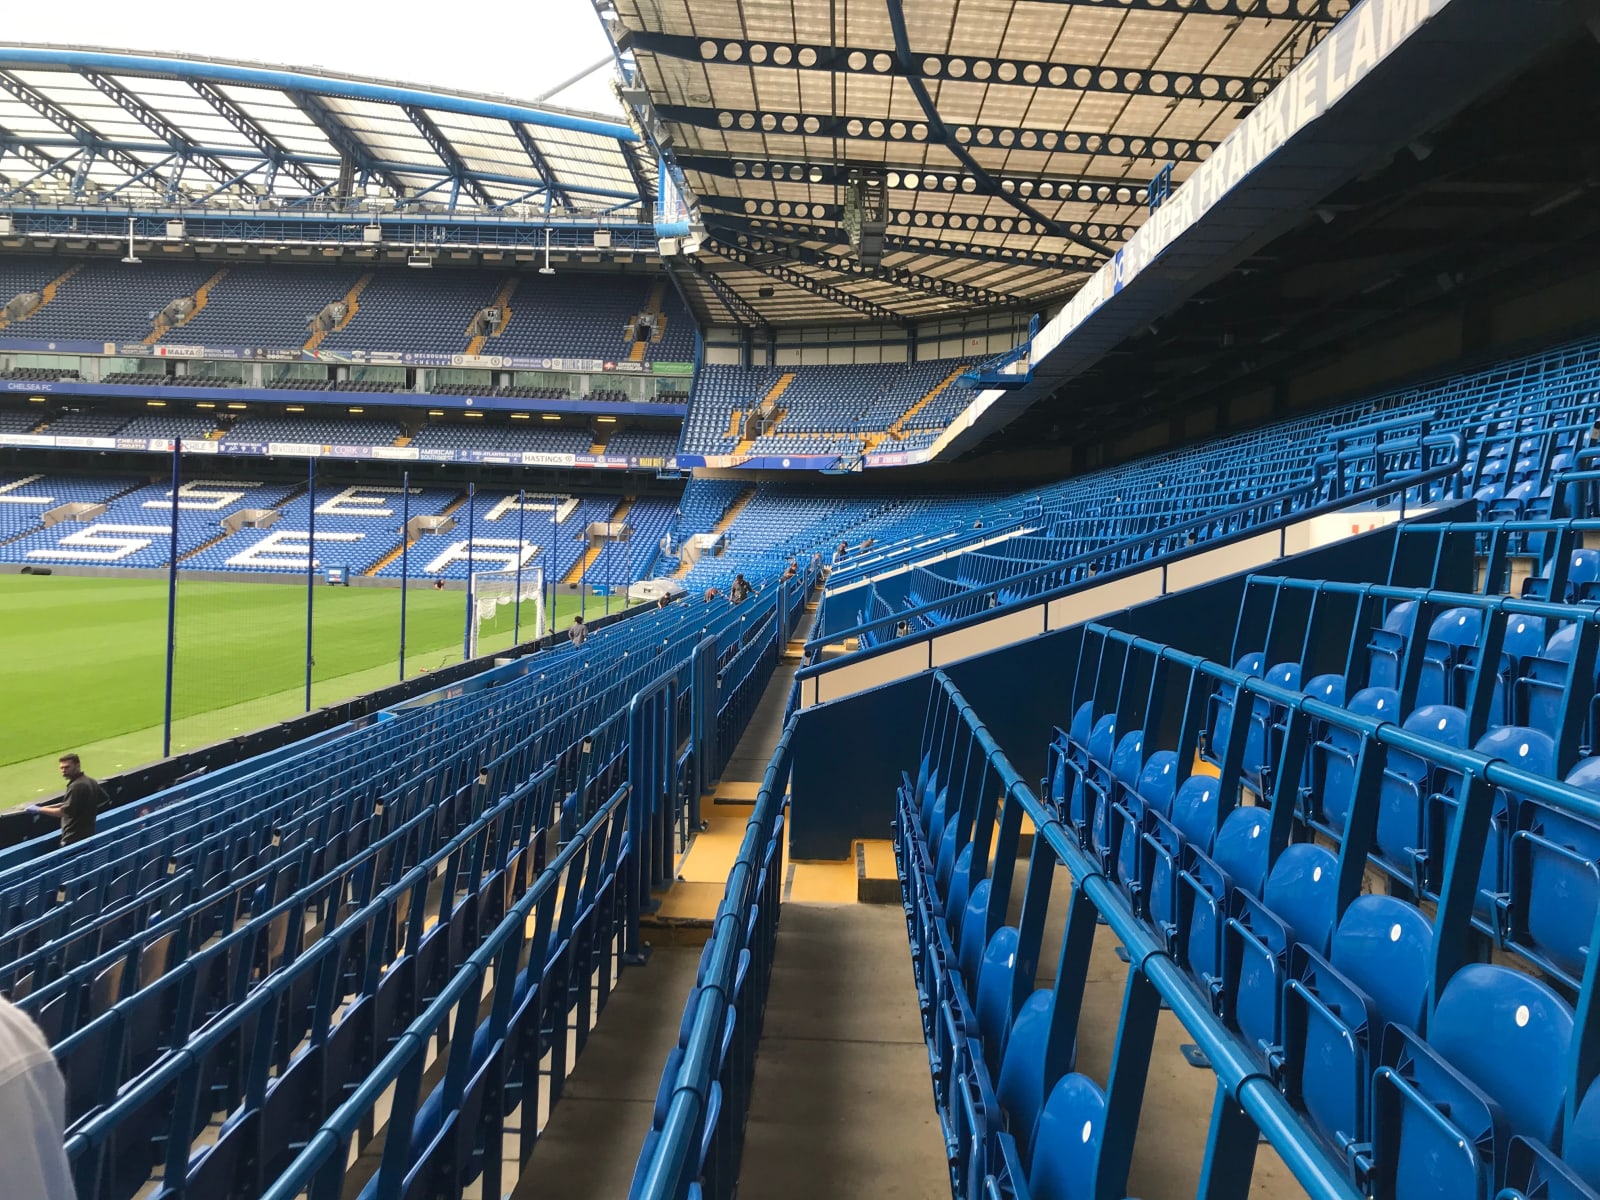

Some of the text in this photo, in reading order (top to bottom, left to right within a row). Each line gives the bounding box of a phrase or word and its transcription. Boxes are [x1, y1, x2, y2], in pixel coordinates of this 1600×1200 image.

[1139, 177, 1194, 258] SUPER
[1199, 57, 1318, 212] FRANKIE
[167, 348, 195, 356] MALTA
[7, 382, 41, 391] CHELSEA
[334, 446, 358, 454] CORK
[420, 448, 455, 456] AMERICAN
[525, 455, 564, 463] HASTINGS
